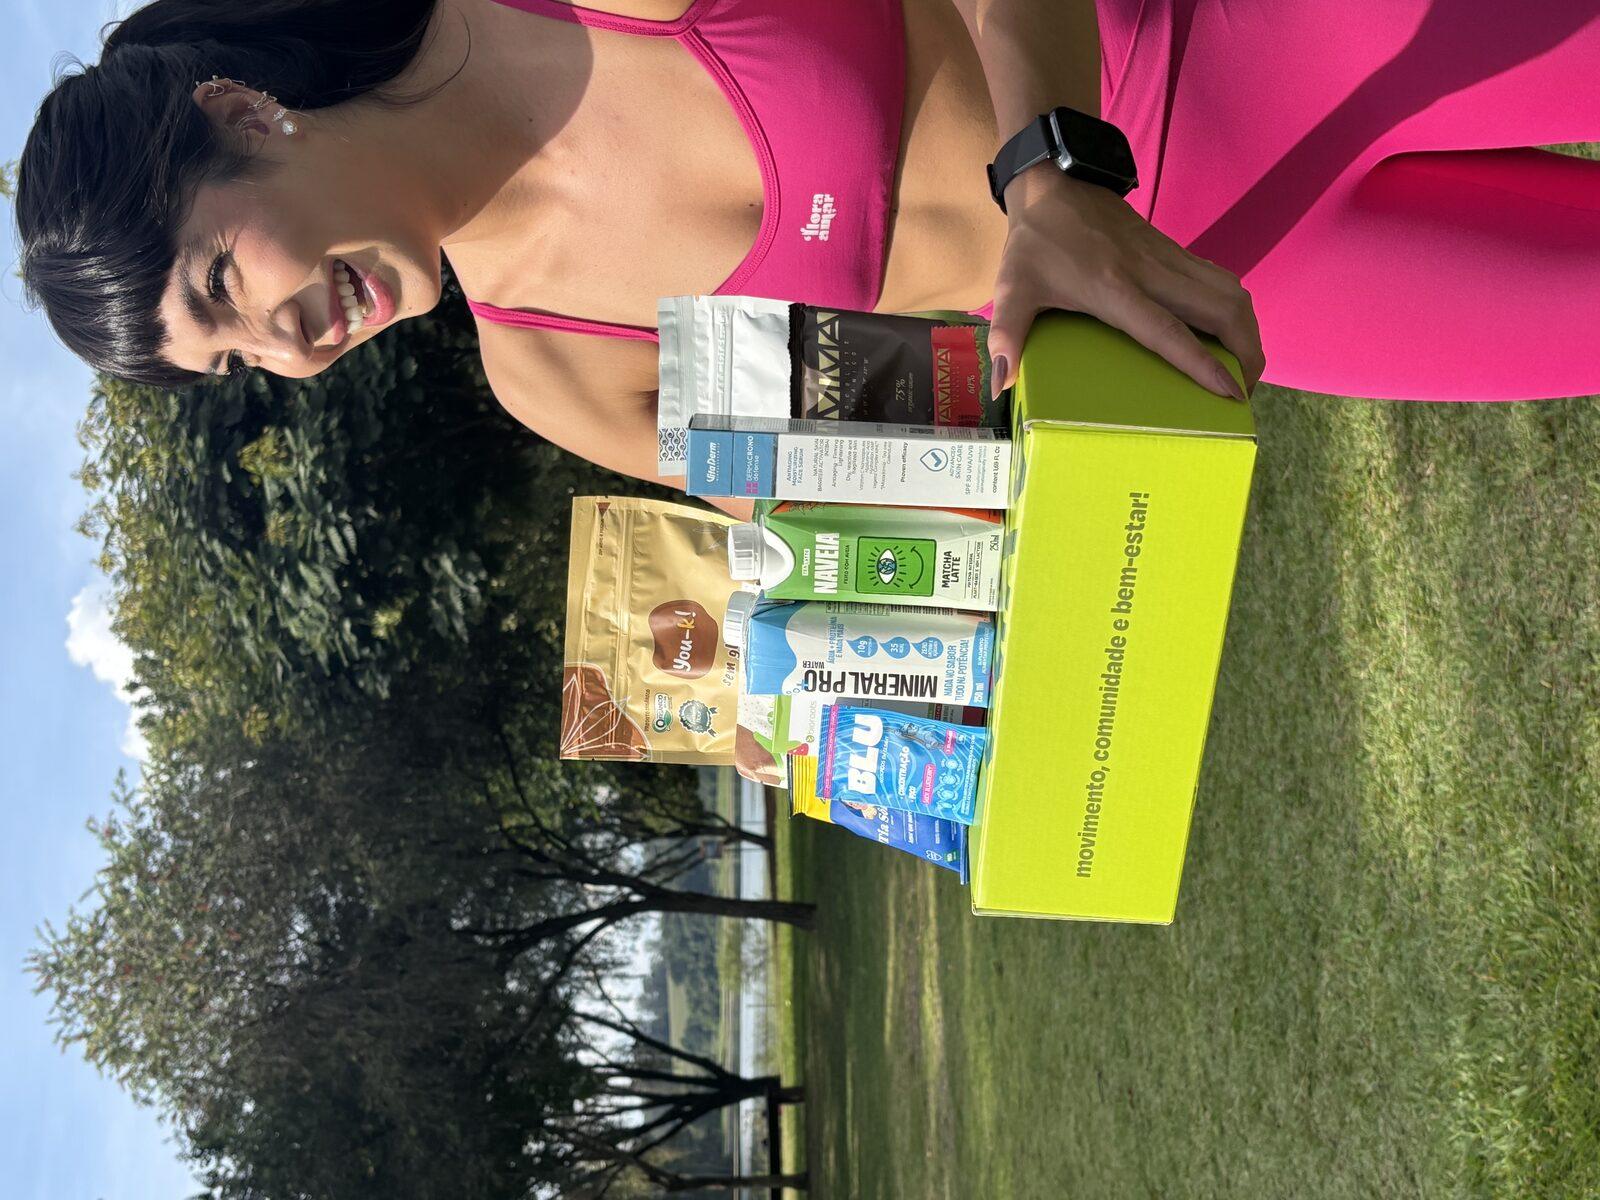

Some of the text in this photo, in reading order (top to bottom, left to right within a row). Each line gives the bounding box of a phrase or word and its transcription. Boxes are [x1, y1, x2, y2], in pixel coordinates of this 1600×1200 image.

[800, 194, 824, 241] flora
[818, 194, 836, 241] amar
[816, 312, 840, 421] MMA
[966, 375, 975, 394] 60%
[895, 378, 906, 400] 75%
[746, 436, 754, 481] DERMACRONO
[966, 474, 971, 482] 30
[989, 534, 1000, 551] 250ml
[814, 533, 840, 594] NAVEIA
[942, 551, 952, 588] MATCHA
[950, 557, 960, 582] LATTE
[672, 610, 696, 671] You-k!
[826, 650, 835, 664] ÁGUA
[836, 639, 844, 653] NADA
[857, 640, 867, 654] 10g
[891, 643, 898, 652] 35
[722, 645, 740, 686] sem gl
[802, 660, 824, 669] WATER
[944, 645, 956, 696] NADA NO SABOR
[955, 639, 969, 701] TUDO NA POTÊNCIA!
[973, 682, 984, 703] 250 ml
[1074, 492, 1150, 878] movimento, comunidade e bem-estar!
[847, 714, 883, 794] BLU
[898, 746, 910, 796] CONCENTRAÇÃO
[877, 806, 889, 844] Tia Sô
